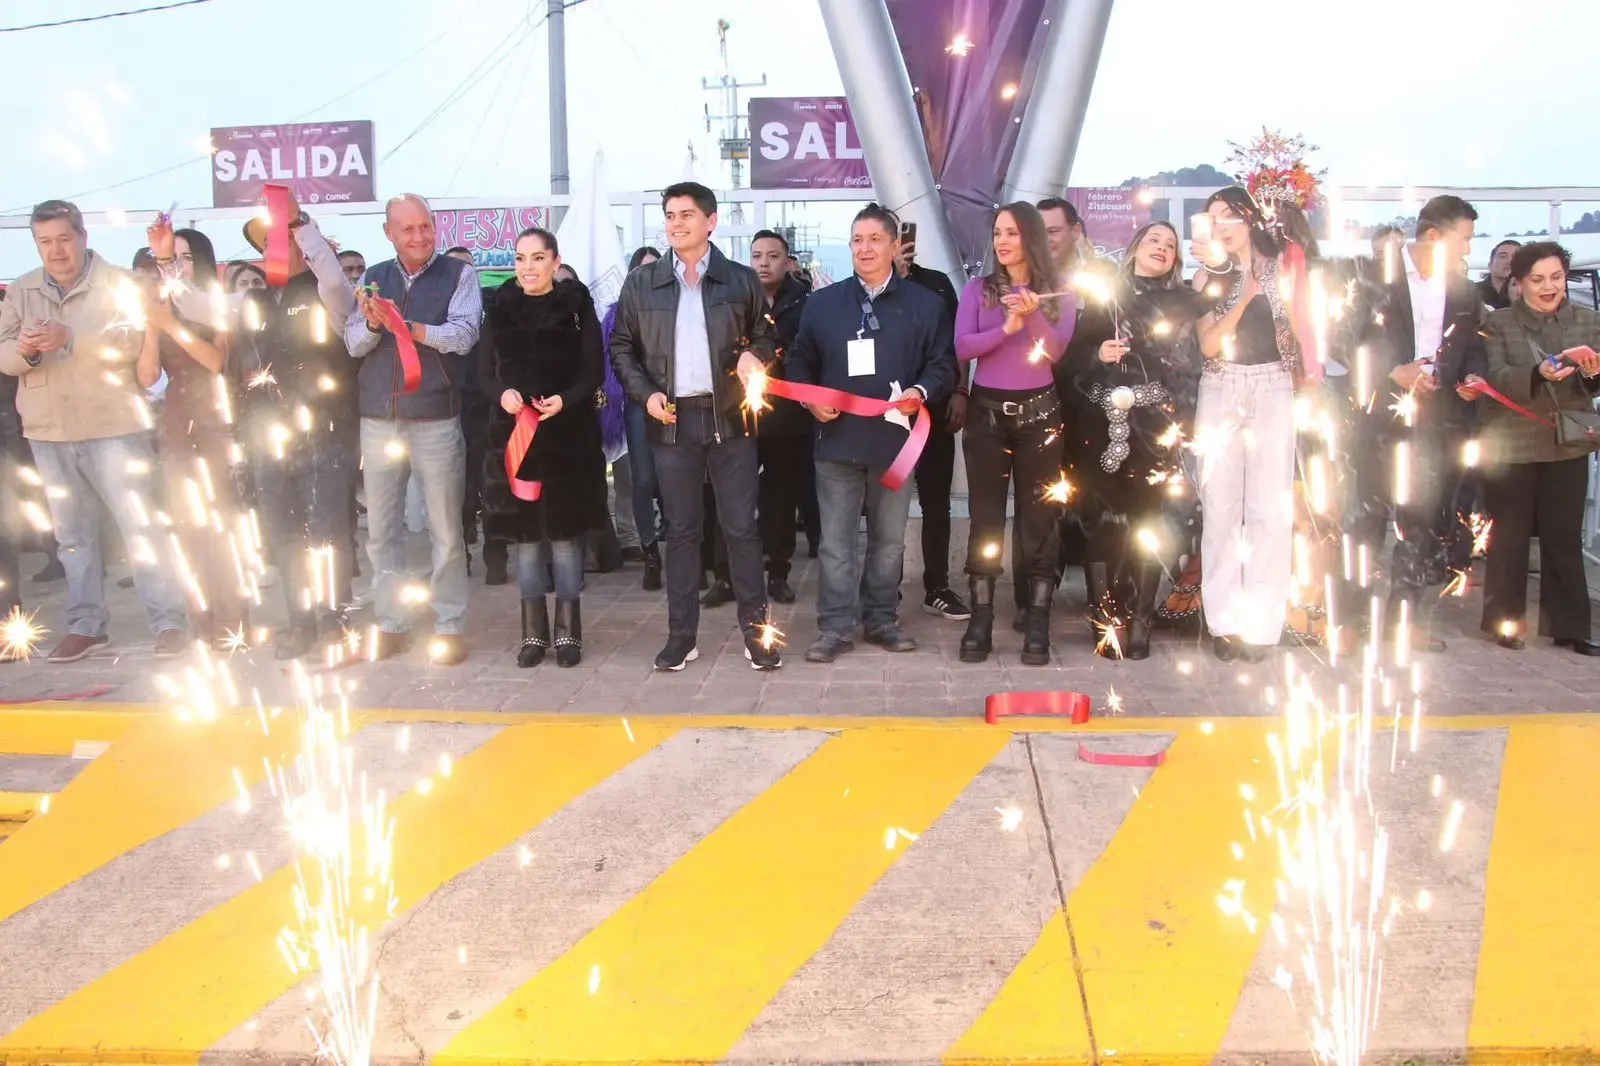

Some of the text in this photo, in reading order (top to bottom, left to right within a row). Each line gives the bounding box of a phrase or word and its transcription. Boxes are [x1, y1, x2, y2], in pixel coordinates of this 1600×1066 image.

[760, 121, 863, 160] SAL
[215, 143, 368, 182] SALIDA
[325, 192, 352, 201] Comex
[1088, 192, 1122, 201] febrero
